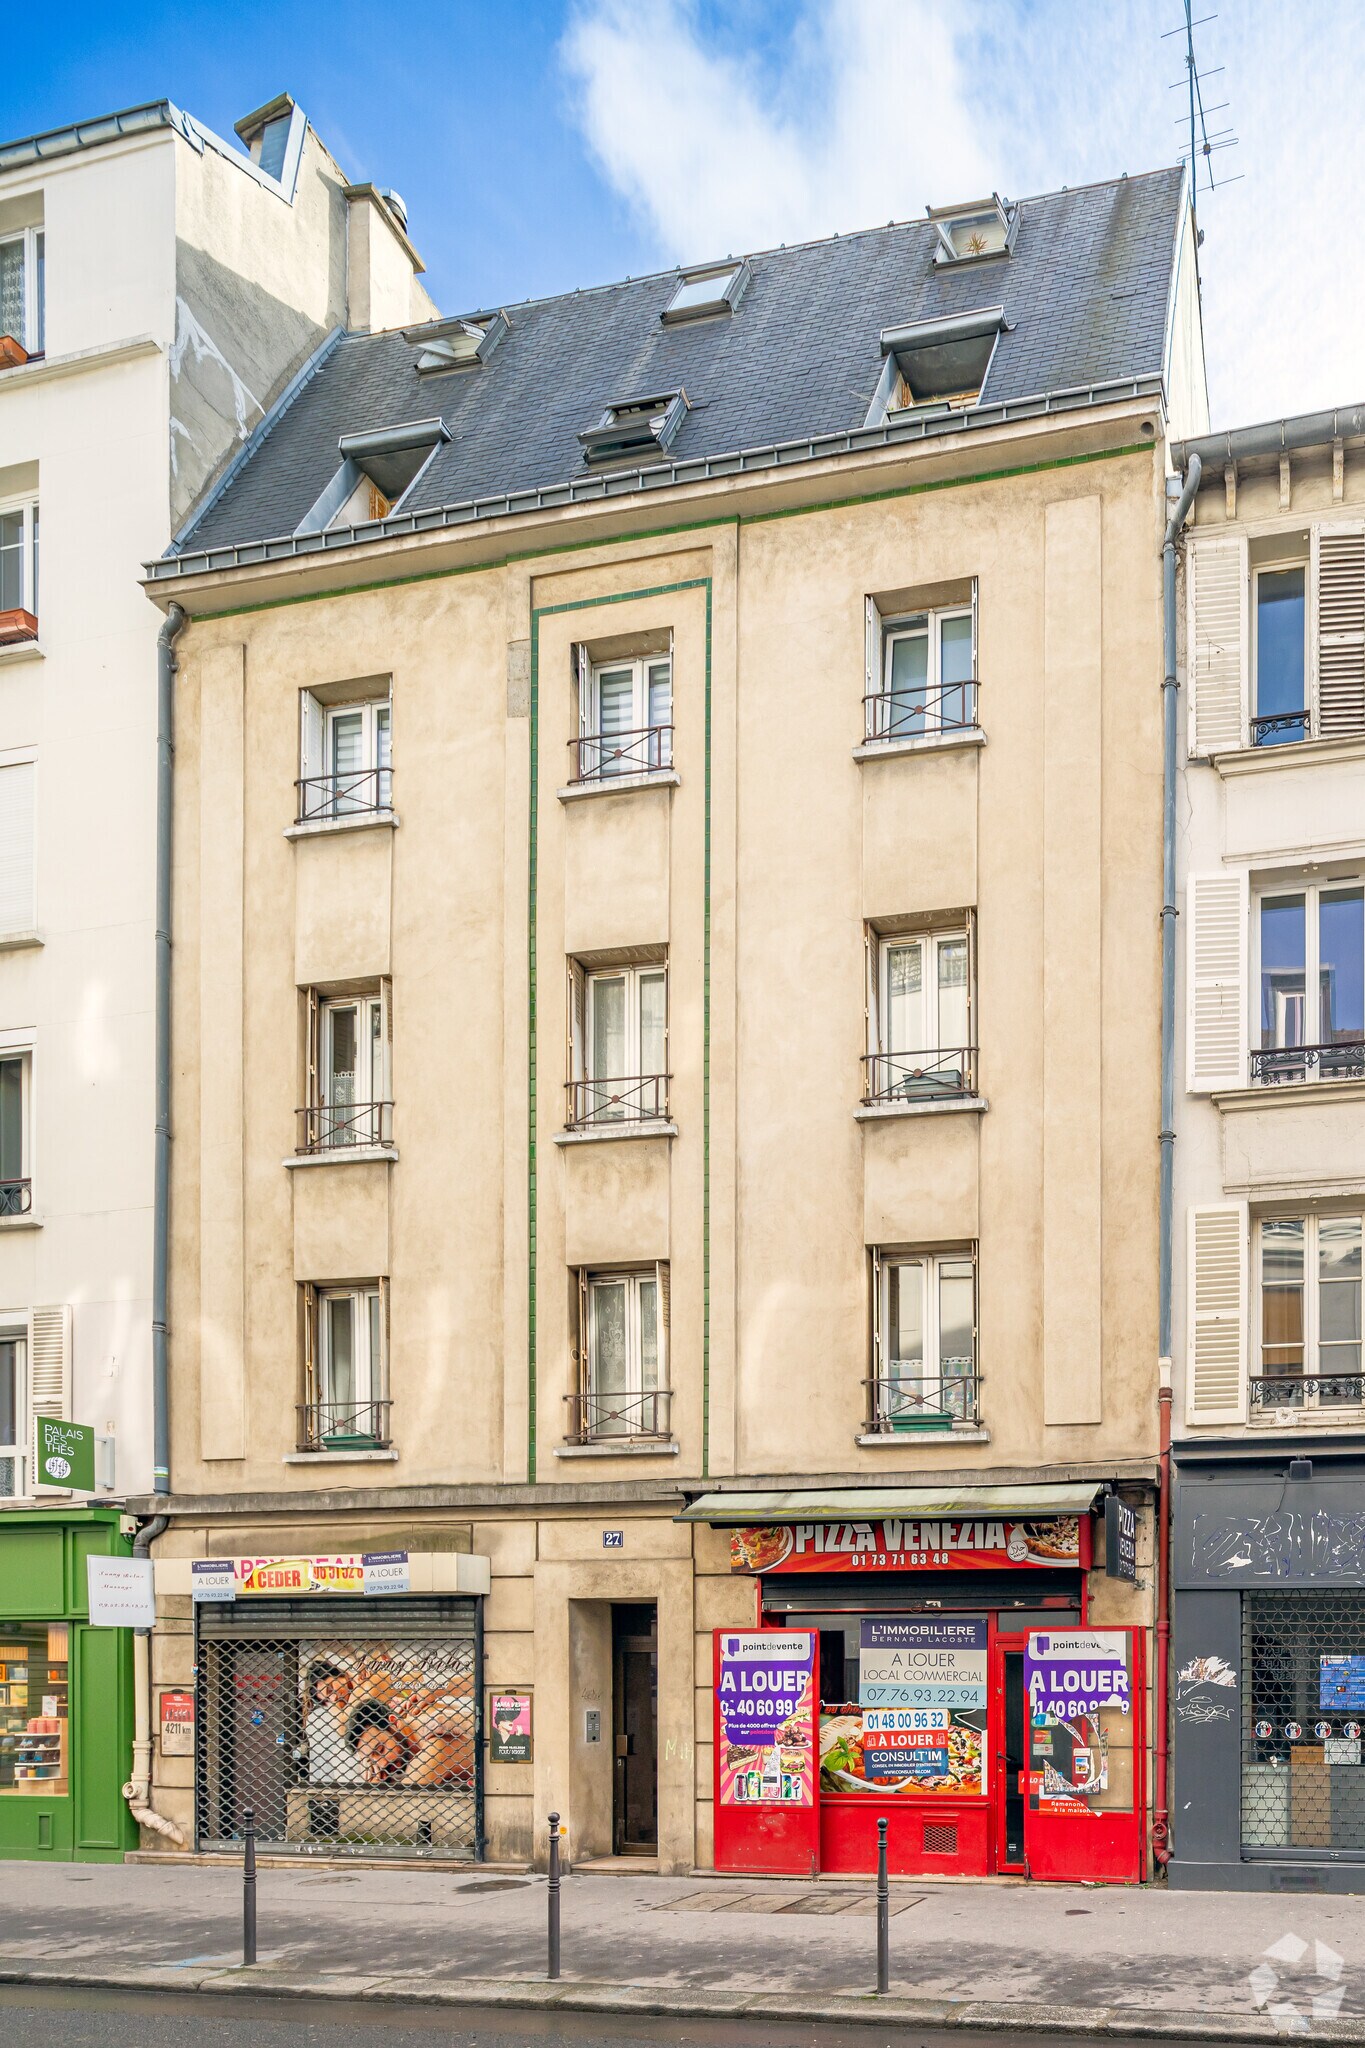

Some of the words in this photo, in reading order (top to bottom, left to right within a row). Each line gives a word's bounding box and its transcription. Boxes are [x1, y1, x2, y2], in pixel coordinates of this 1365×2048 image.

[45, 1424, 84, 1441] PALAIS
[45, 1433, 67, 1446] DES
[1118, 1504, 1135, 1539] PIZZA
[605, 1533, 620, 1545] 27
[795, 1523, 877, 1553] PIZZA
[882, 1519, 1007, 1551] VENEZIA
[852, 1554, 866, 1566] 01
[872, 1553, 886, 1566] 73
[892, 1553, 905, 1565] 71
[911, 1553, 927, 1565] 63
[933, 1552, 949, 1564] 48
[257, 1570, 301, 1588] CEDER
[369, 1570, 376, 1578] A
[377, 1567, 403, 1578] LOUER
[197, 1577, 204, 1585] A
[205, 1577, 229, 1585] LOUER
[871, 1625, 976, 1636] L'IMMOBILIERE
[871, 1635, 923, 1643] BERNARD
[743, 1642, 803, 1653] pointdevente
[891, 1653, 903, 1667] A
[908, 1653, 956, 1667] LOUER
[720, 1671, 737, 1692] A
[740, 1670, 810, 1692] LOUER
[863, 1669, 900, 1681] LOCAL
[903, 1670, 983, 1682] COMMERCIAL
[1028, 1670, 1046, 1693] A
[1050, 1669, 1129, 1693] LOUER
[866, 1688, 979, 1703] 07.76.93.22.94
[736, 1699, 755, 1716] 40
[756, 1699, 774, 1716] 60
[775, 1699, 793, 1716] 99
[1067, 1700, 1087, 1717] 60
[867, 1714, 879, 1729] 01
[882, 1713, 895, 1729] 48
[897, 1713, 911, 1728] 00
[914, 1712, 928, 1728] 96
[930, 1711, 944, 1727] 32
[165, 1723, 181, 1734] 4211
[182, 1726, 192, 1734] km
[878, 1733, 887, 1747] À
[890, 1734, 934, 1747] LOUER
[871, 1750, 942, 1763] CONSULT'IM
